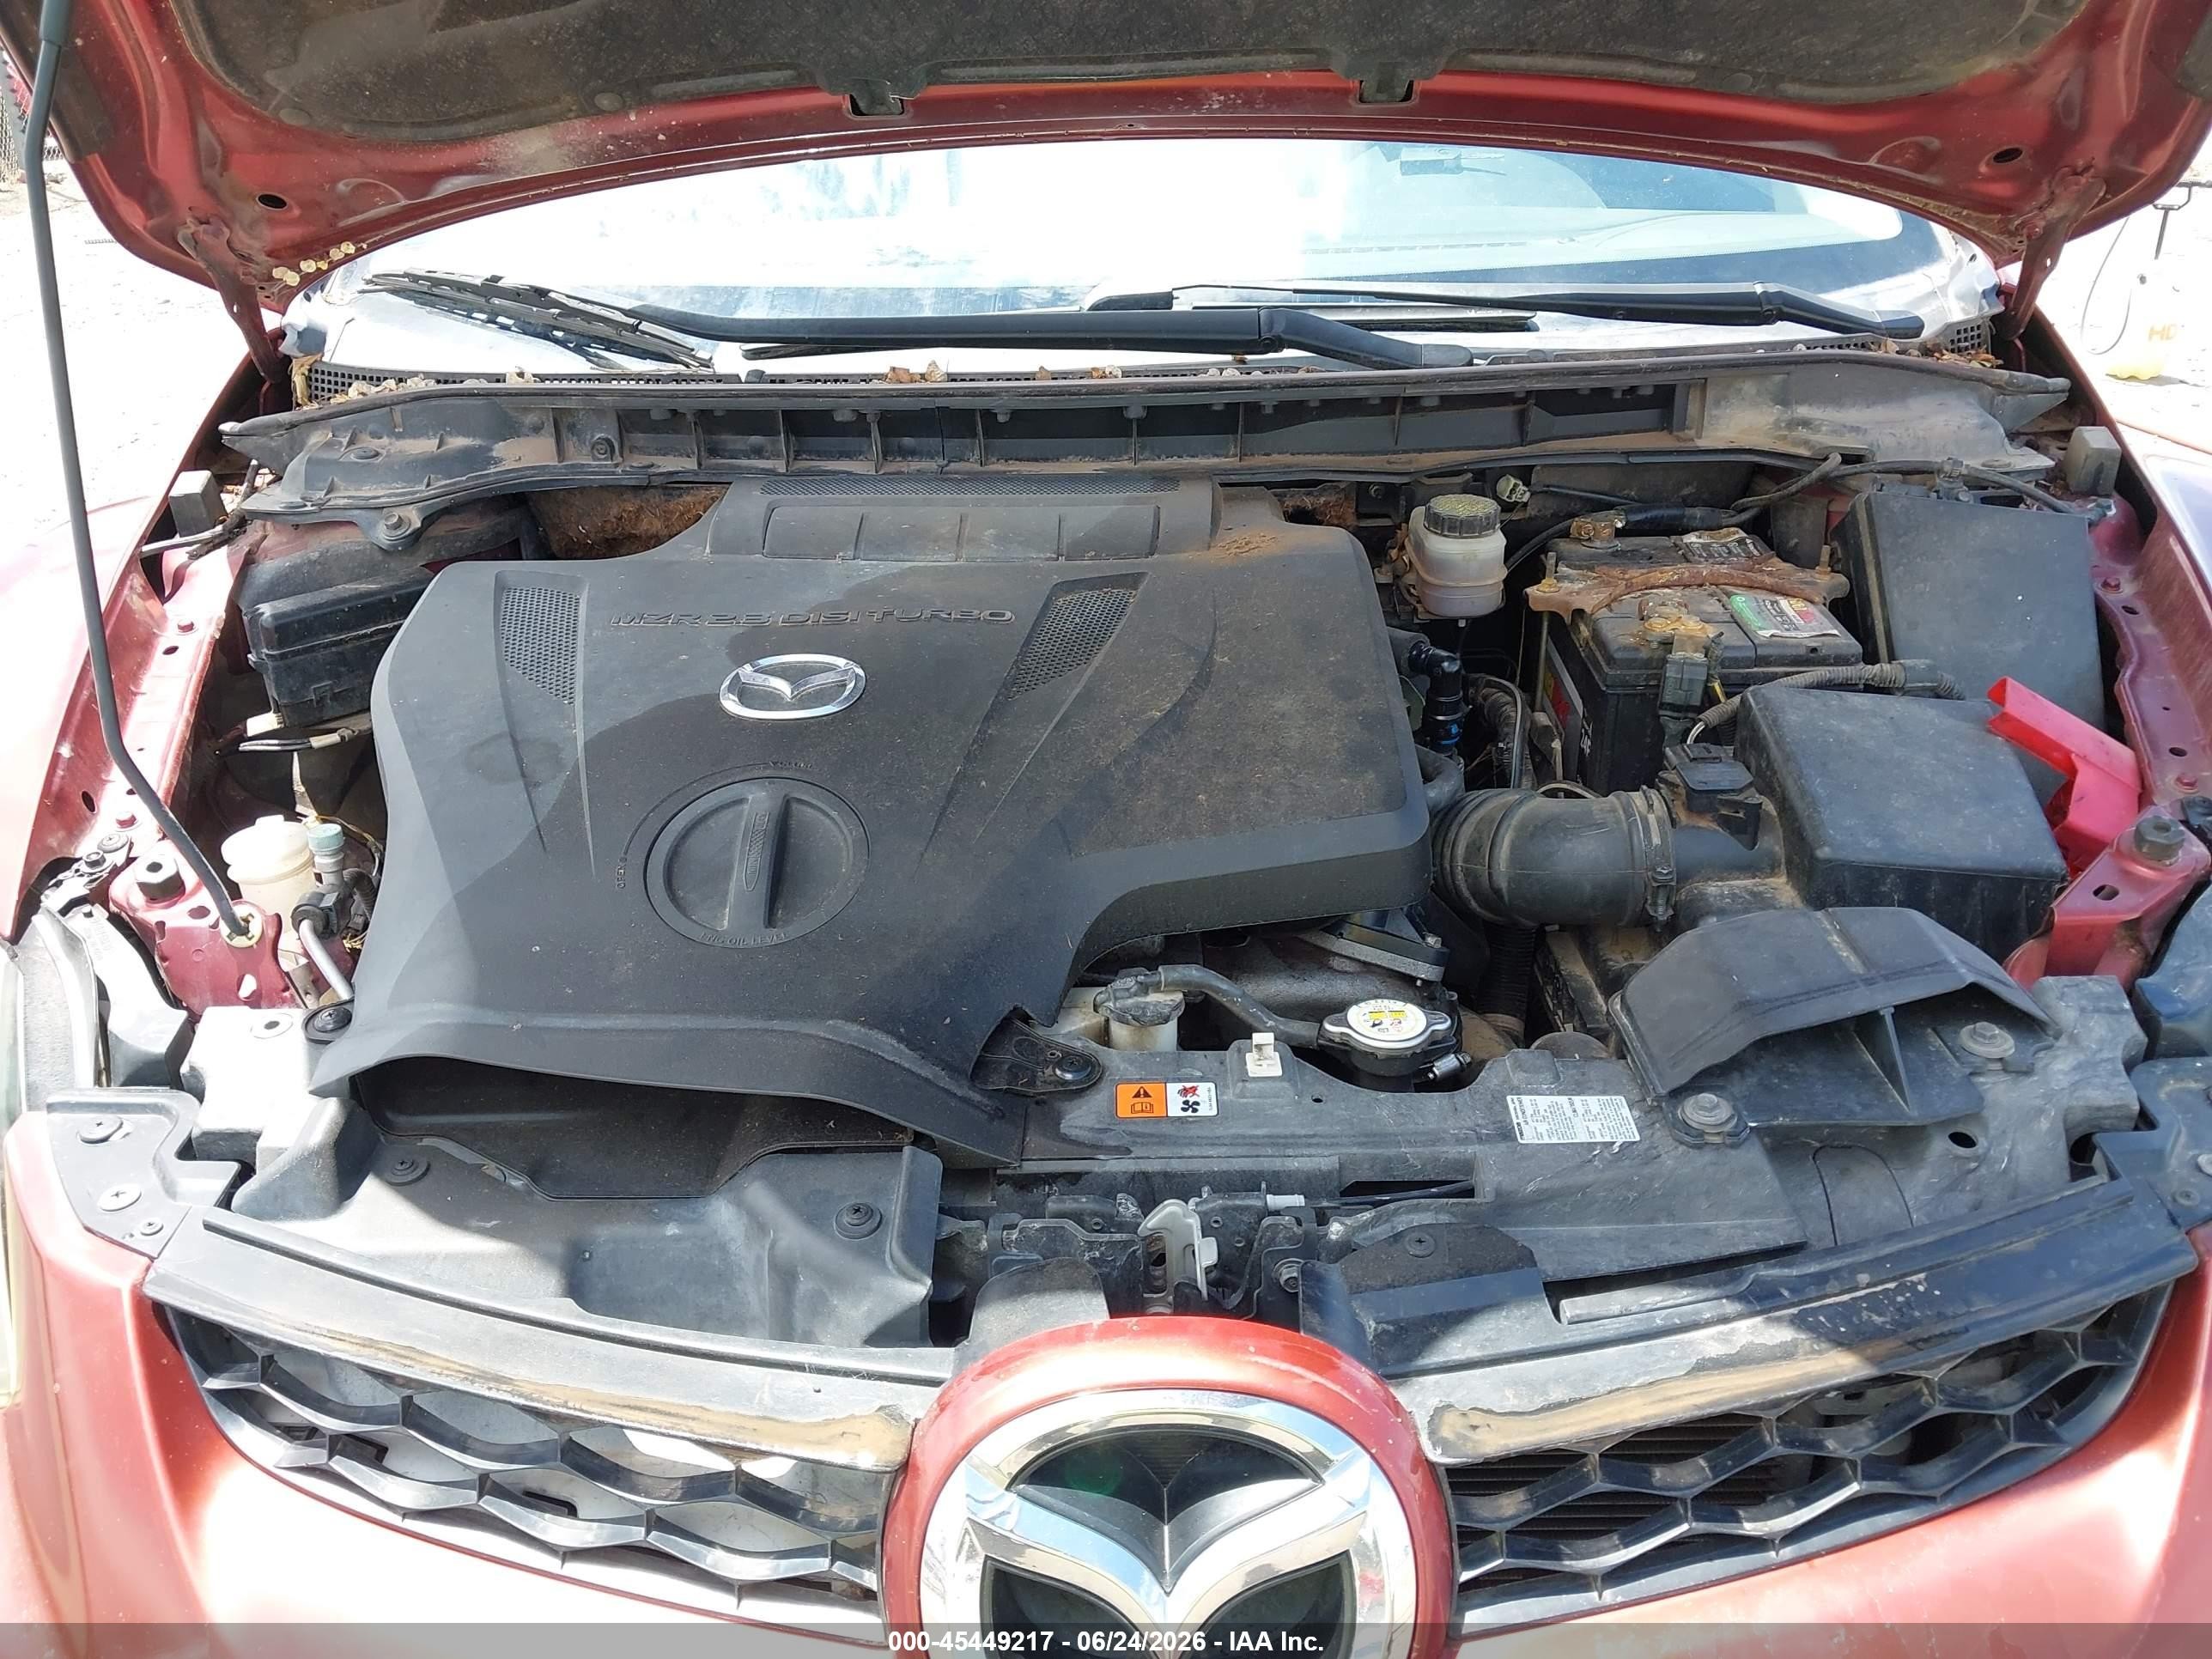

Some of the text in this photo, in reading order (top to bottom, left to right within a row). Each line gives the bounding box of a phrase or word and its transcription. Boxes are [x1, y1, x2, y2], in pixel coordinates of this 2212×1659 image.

[611, 611, 702, 627] MZR
[778, 611, 861, 626] DISI
[866, 606, 1016, 625] TURBO
